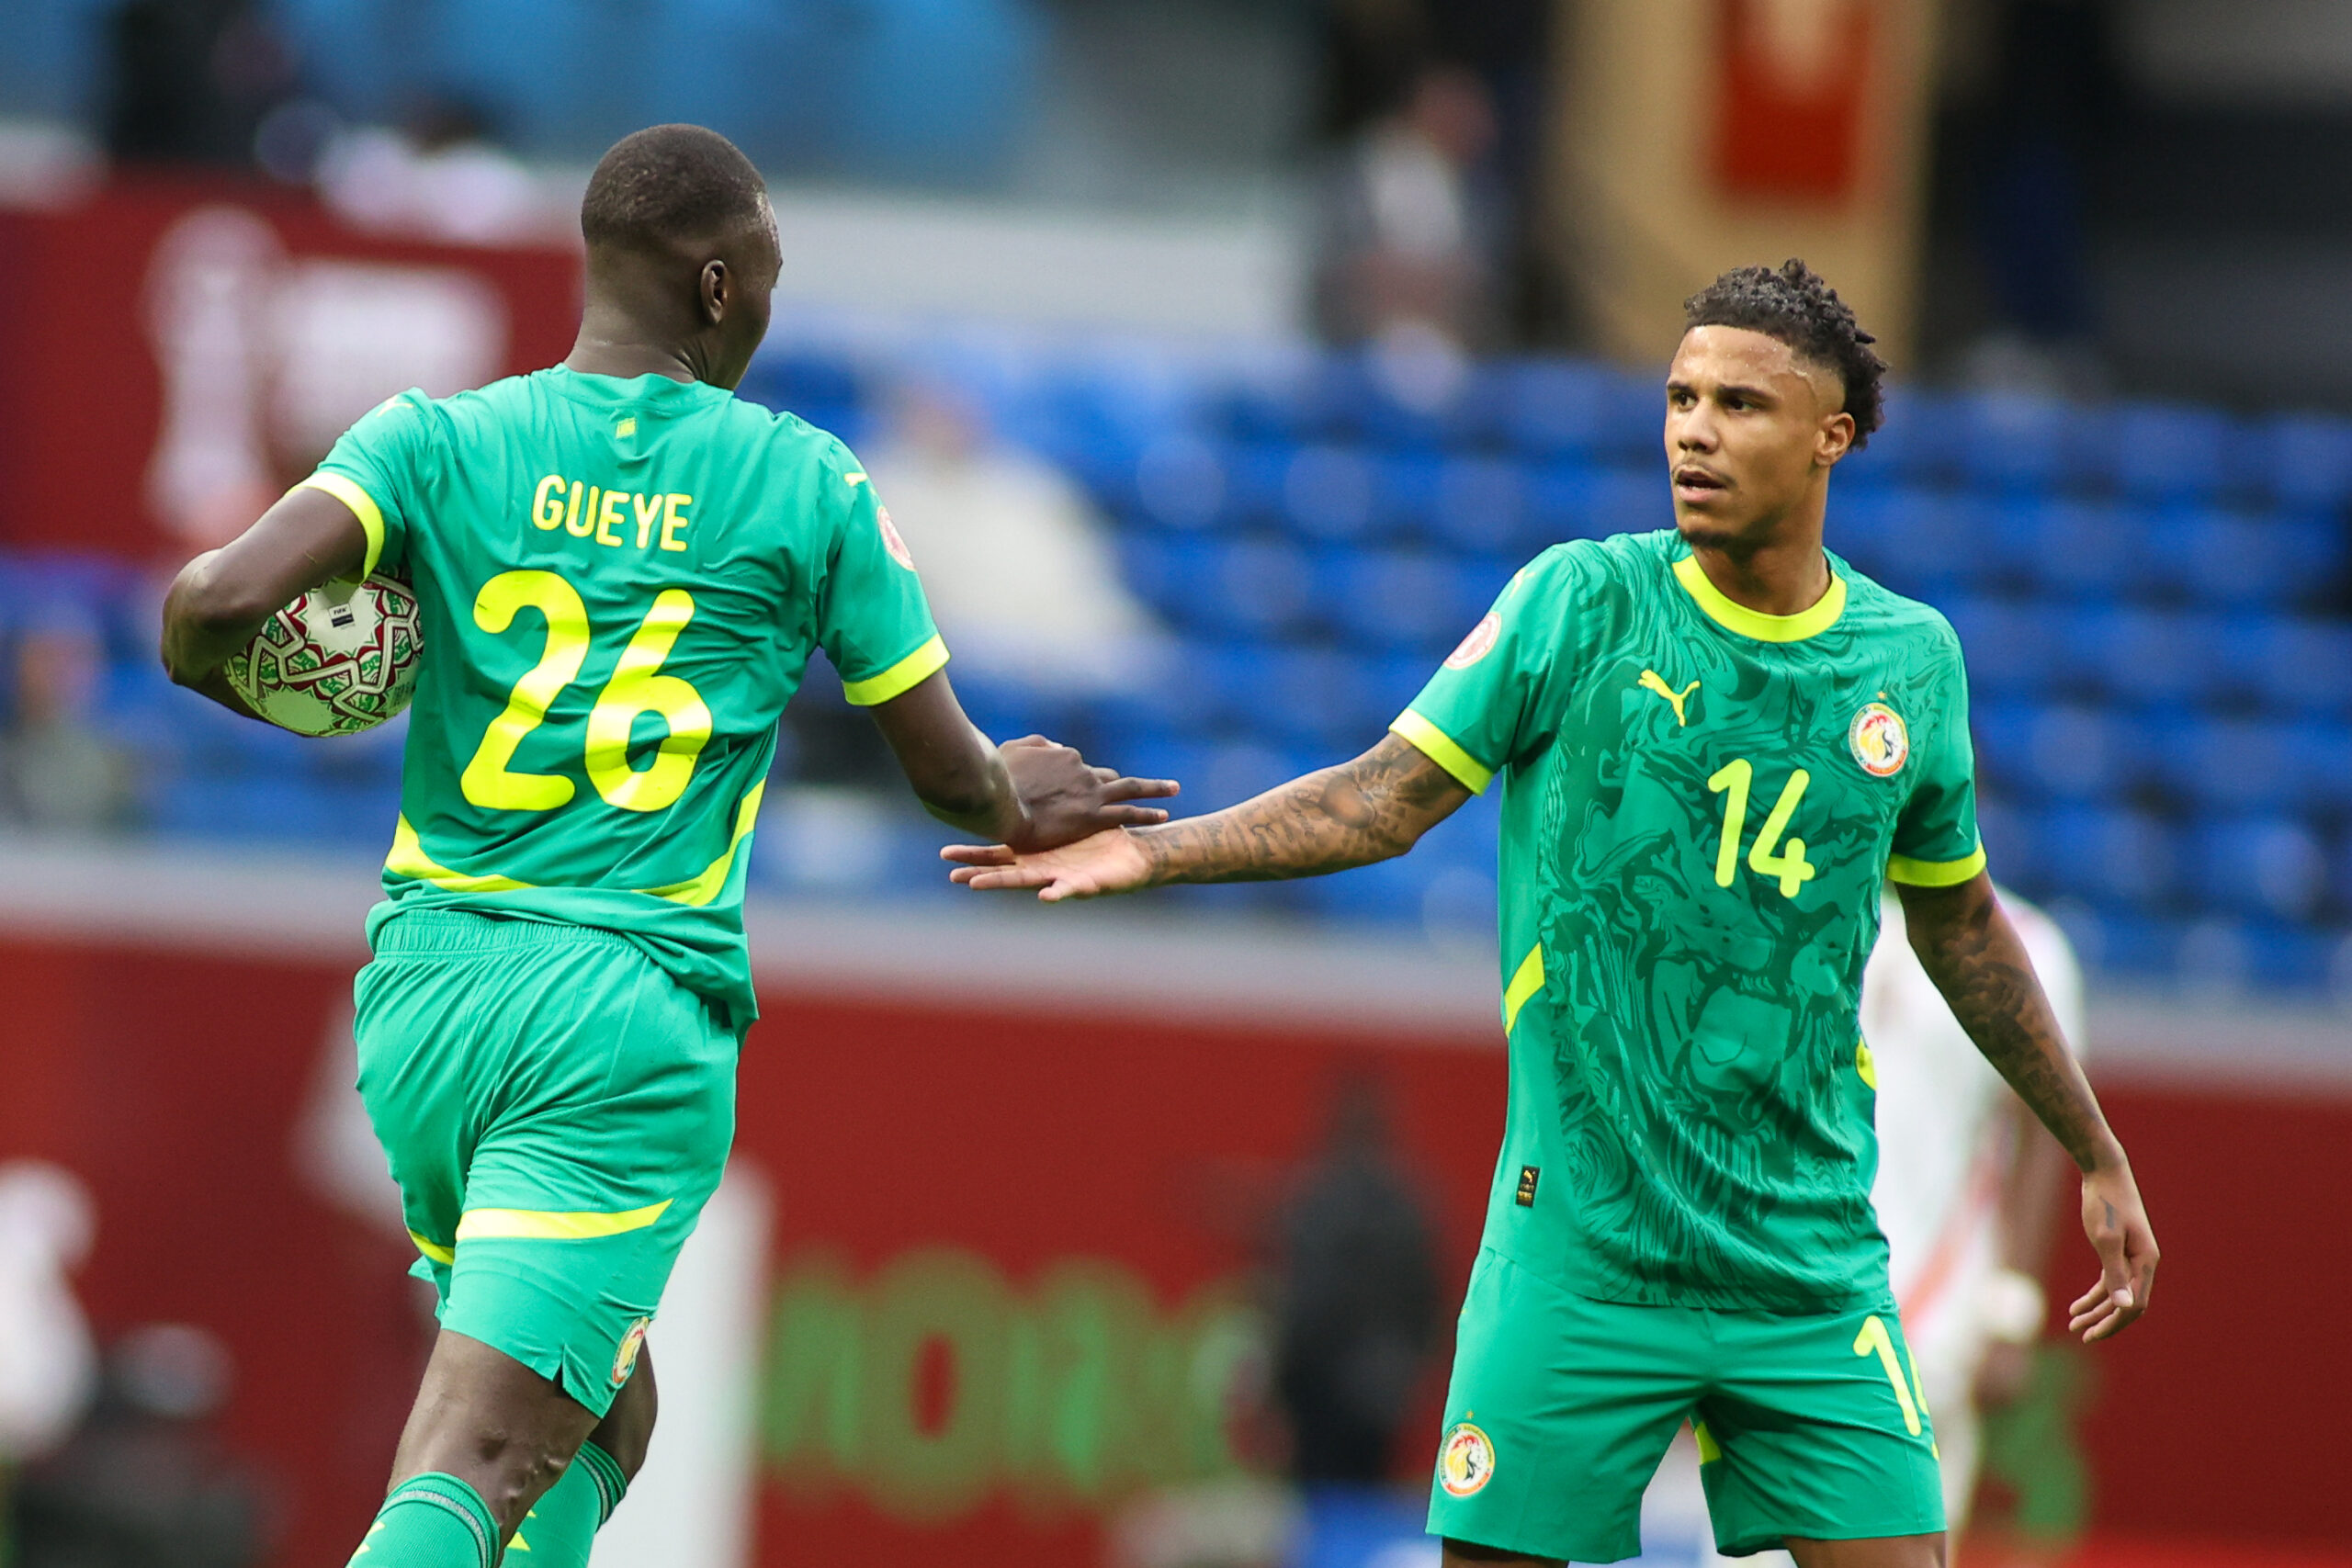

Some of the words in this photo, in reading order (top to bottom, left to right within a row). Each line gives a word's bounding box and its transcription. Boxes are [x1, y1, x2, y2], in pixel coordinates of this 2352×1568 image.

[532, 475, 694, 552] GUEYE
[460, 570, 713, 812] 26
[1708, 759, 1815, 898] 14
